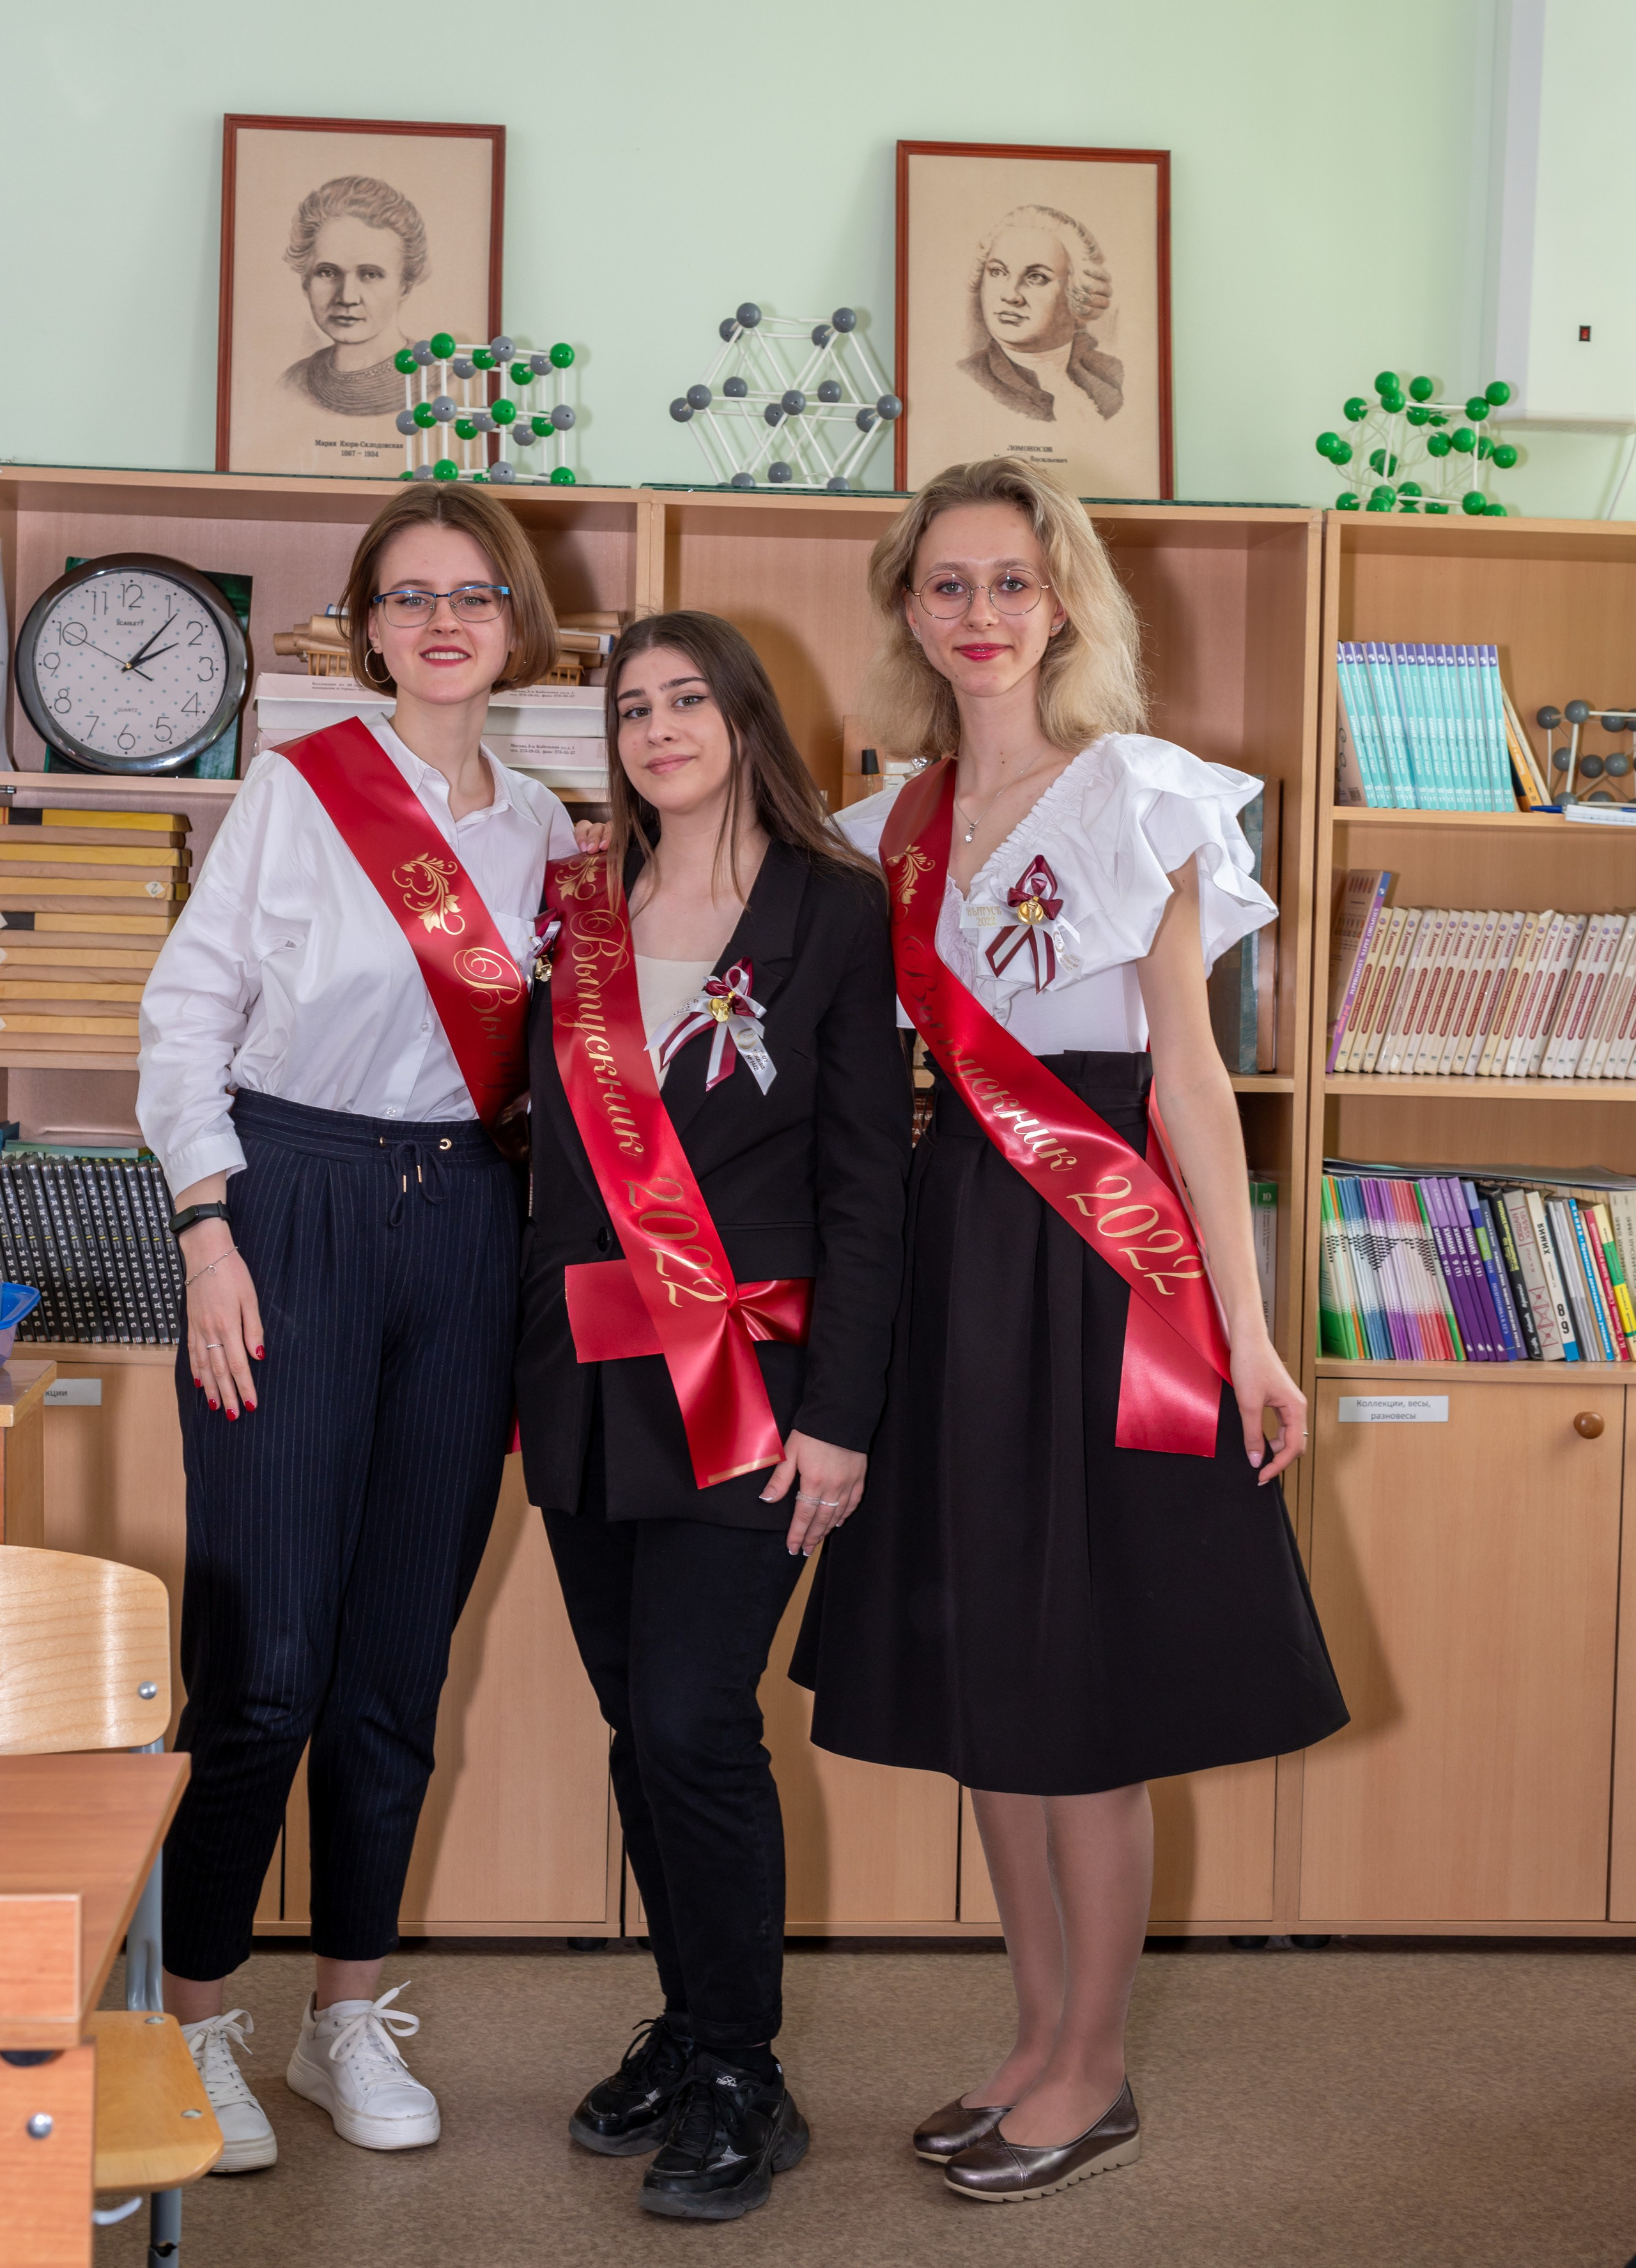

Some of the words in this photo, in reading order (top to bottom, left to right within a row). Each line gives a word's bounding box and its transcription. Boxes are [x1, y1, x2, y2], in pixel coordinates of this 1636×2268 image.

[340, 441, 403, 449] Кюри-Склодовская
[1007, 445, 1053, 453] ЛОМОНОСОВ
[91, 591, 107, 615] 11
[120, 584, 143, 608] 12
[165, 595, 171, 618] 1
[57, 621, 88, 646] 10
[186, 621, 203, 645] 2
[43, 652, 60, 677] 9
[197, 657, 213, 682] 3
[54, 688, 72, 714] 8
[180, 692, 200, 717] 4
[84, 715, 99, 740] 7
[117, 724, 135, 750] 6
[154, 717, 172, 742] 5
[1350, 715, 1358, 736] ХИМИЯ
[1370, 715, 1378, 736] ХИМИЯ
[1381, 716, 1389, 736] ХИМИЯ
[966, 906, 1002, 916] ВЫПУСК
[976, 916, 997, 926] 2022
[1370, 928, 1384, 954] Химия
[1398, 930, 1412, 956] Химия
[1439, 931, 1453, 957] Химия
[1463, 933, 1477, 960] Химия
[1490, 933, 1504, 960] Химия
[1516, 931, 1531, 958] Химия
[1541, 934, 1555, 960] Химия
[1566, 933, 1580, 958] Химия
[1593, 937, 1606, 963] Химия
[558, 909, 644, 1158] Выпускник
[3, 1177, 18, 1223] химия
[15, 1179, 31, 1225] химия
[32, 1179, 47, 1225] химия
[58, 1179, 74, 1225] химия
[73, 1178, 89, 1224] химия
[100, 1179, 115, 1226] химия
[114, 1179, 129, 1226] химия
[141, 1180, 156, 1227] химия
[154, 1181, 169, 1227] химия
[1262, 1193, 1272, 1202] 10
[46, 1179, 68, 1255] задачник
[1512, 1212, 1525, 1241] ОБЩАЯ
[1519, 1211, 1531, 1239] ХИМИЯ
[621, 1177, 727, 1308] 2022
[1066, 1175, 1205, 1296] 2022
[1433, 1227, 1446, 1255] ХИМИЯ
[1453, 1227, 1465, 1255] ХИМИЯ
[1536, 1222, 1550, 1254] ХИМИЯ
[1442, 1227, 1456, 1255] ХИМИЯ
[1454, 1267, 1462, 1277] (1)
[1463, 1227, 1477, 1255] ХИМИЯ
[1474, 1267, 1483, 1277] (1)
[32, 1250, 54, 1326] задачник
[47, 1251, 69, 1327] задачник
[74, 1251, 96, 1327] задачник
[88, 1250, 110, 1326] задачник
[102, 1251, 124, 1327] задачник
[115, 1252, 137, 1328] задачник
[128, 1251, 150, 1328] задачник
[143, 1252, 164, 1328] задачник
[155, 1252, 176, 1328] задачник
[1492, 1282, 1504, 1318] ПОДГОТОВКА
[1356, 1399, 1406, 1409] Коллекции,
[1408, 1400, 1431, 1409] весы,
[1371, 1413, 1417, 1421] разновесы
